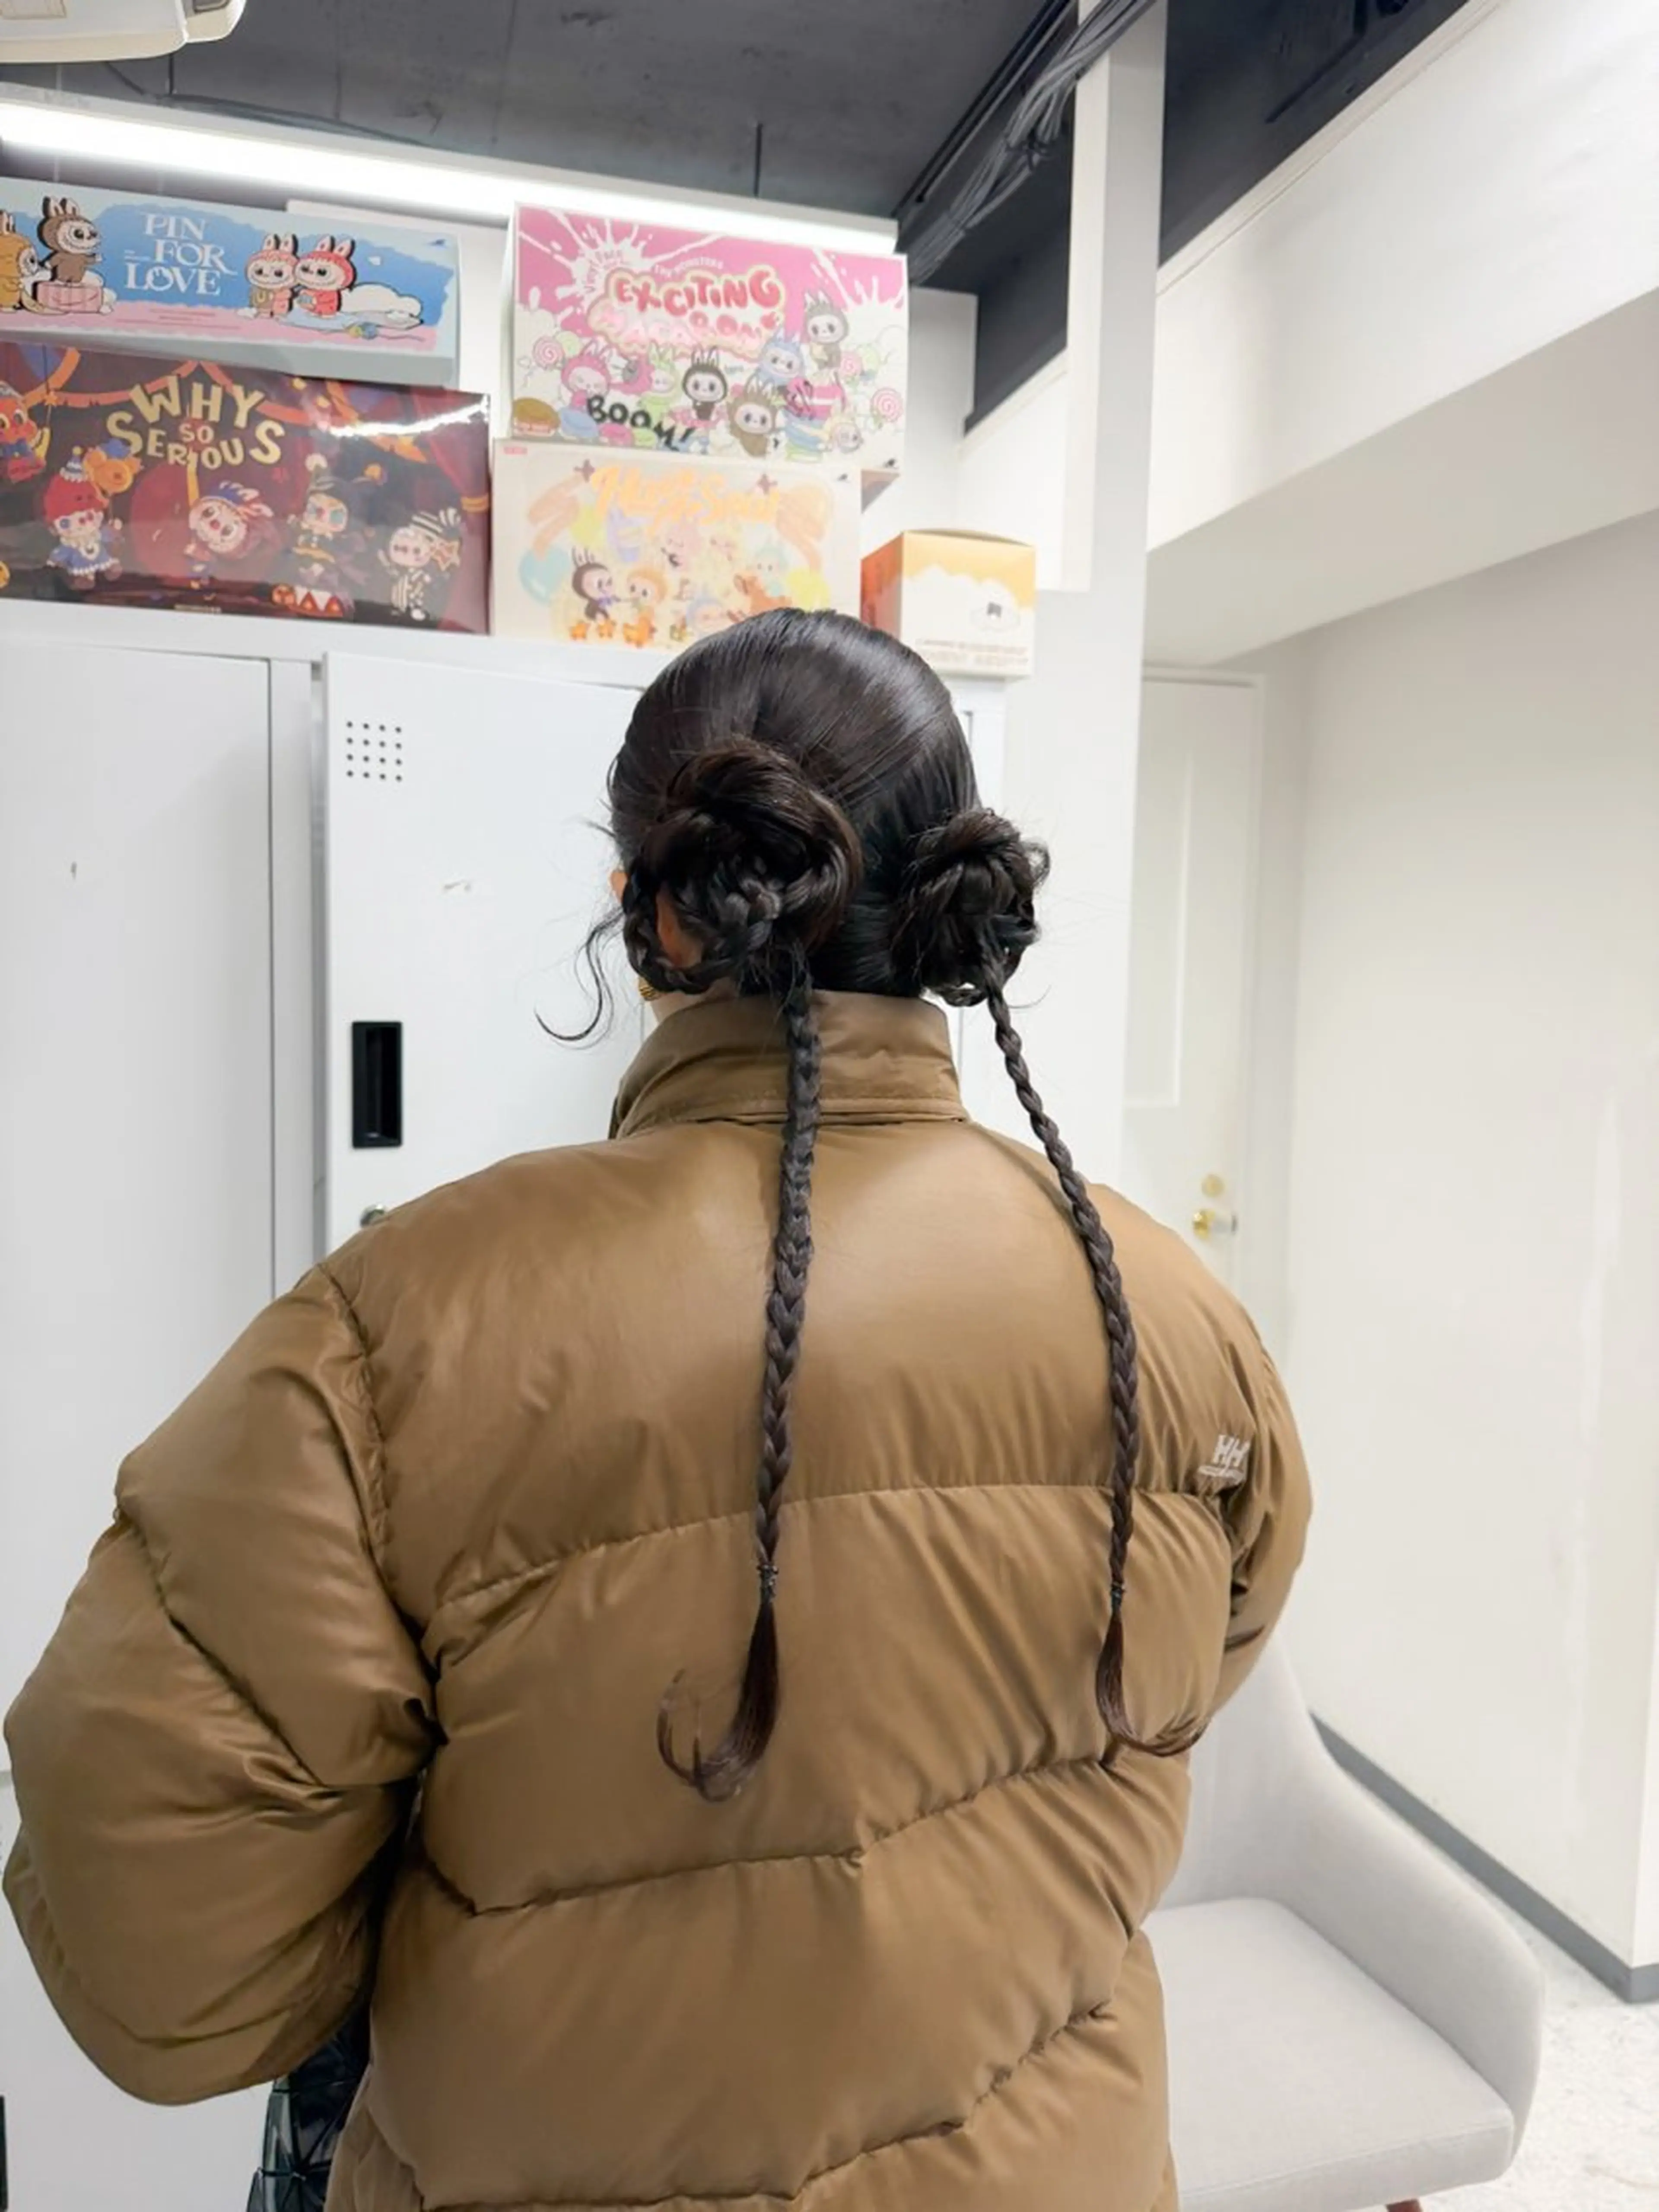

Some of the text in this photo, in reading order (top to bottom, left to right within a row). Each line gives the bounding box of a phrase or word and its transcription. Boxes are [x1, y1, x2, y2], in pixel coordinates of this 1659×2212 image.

[144, 214, 205, 241] PIN
[155, 238, 238, 276] FOR
[124, 262, 221, 295] LOVE
[616, 270, 780, 316] EXCITING
[129, 375, 264, 429] WHY
[106, 410, 285, 469] SERIOUS
[178, 423, 215, 444] SO
